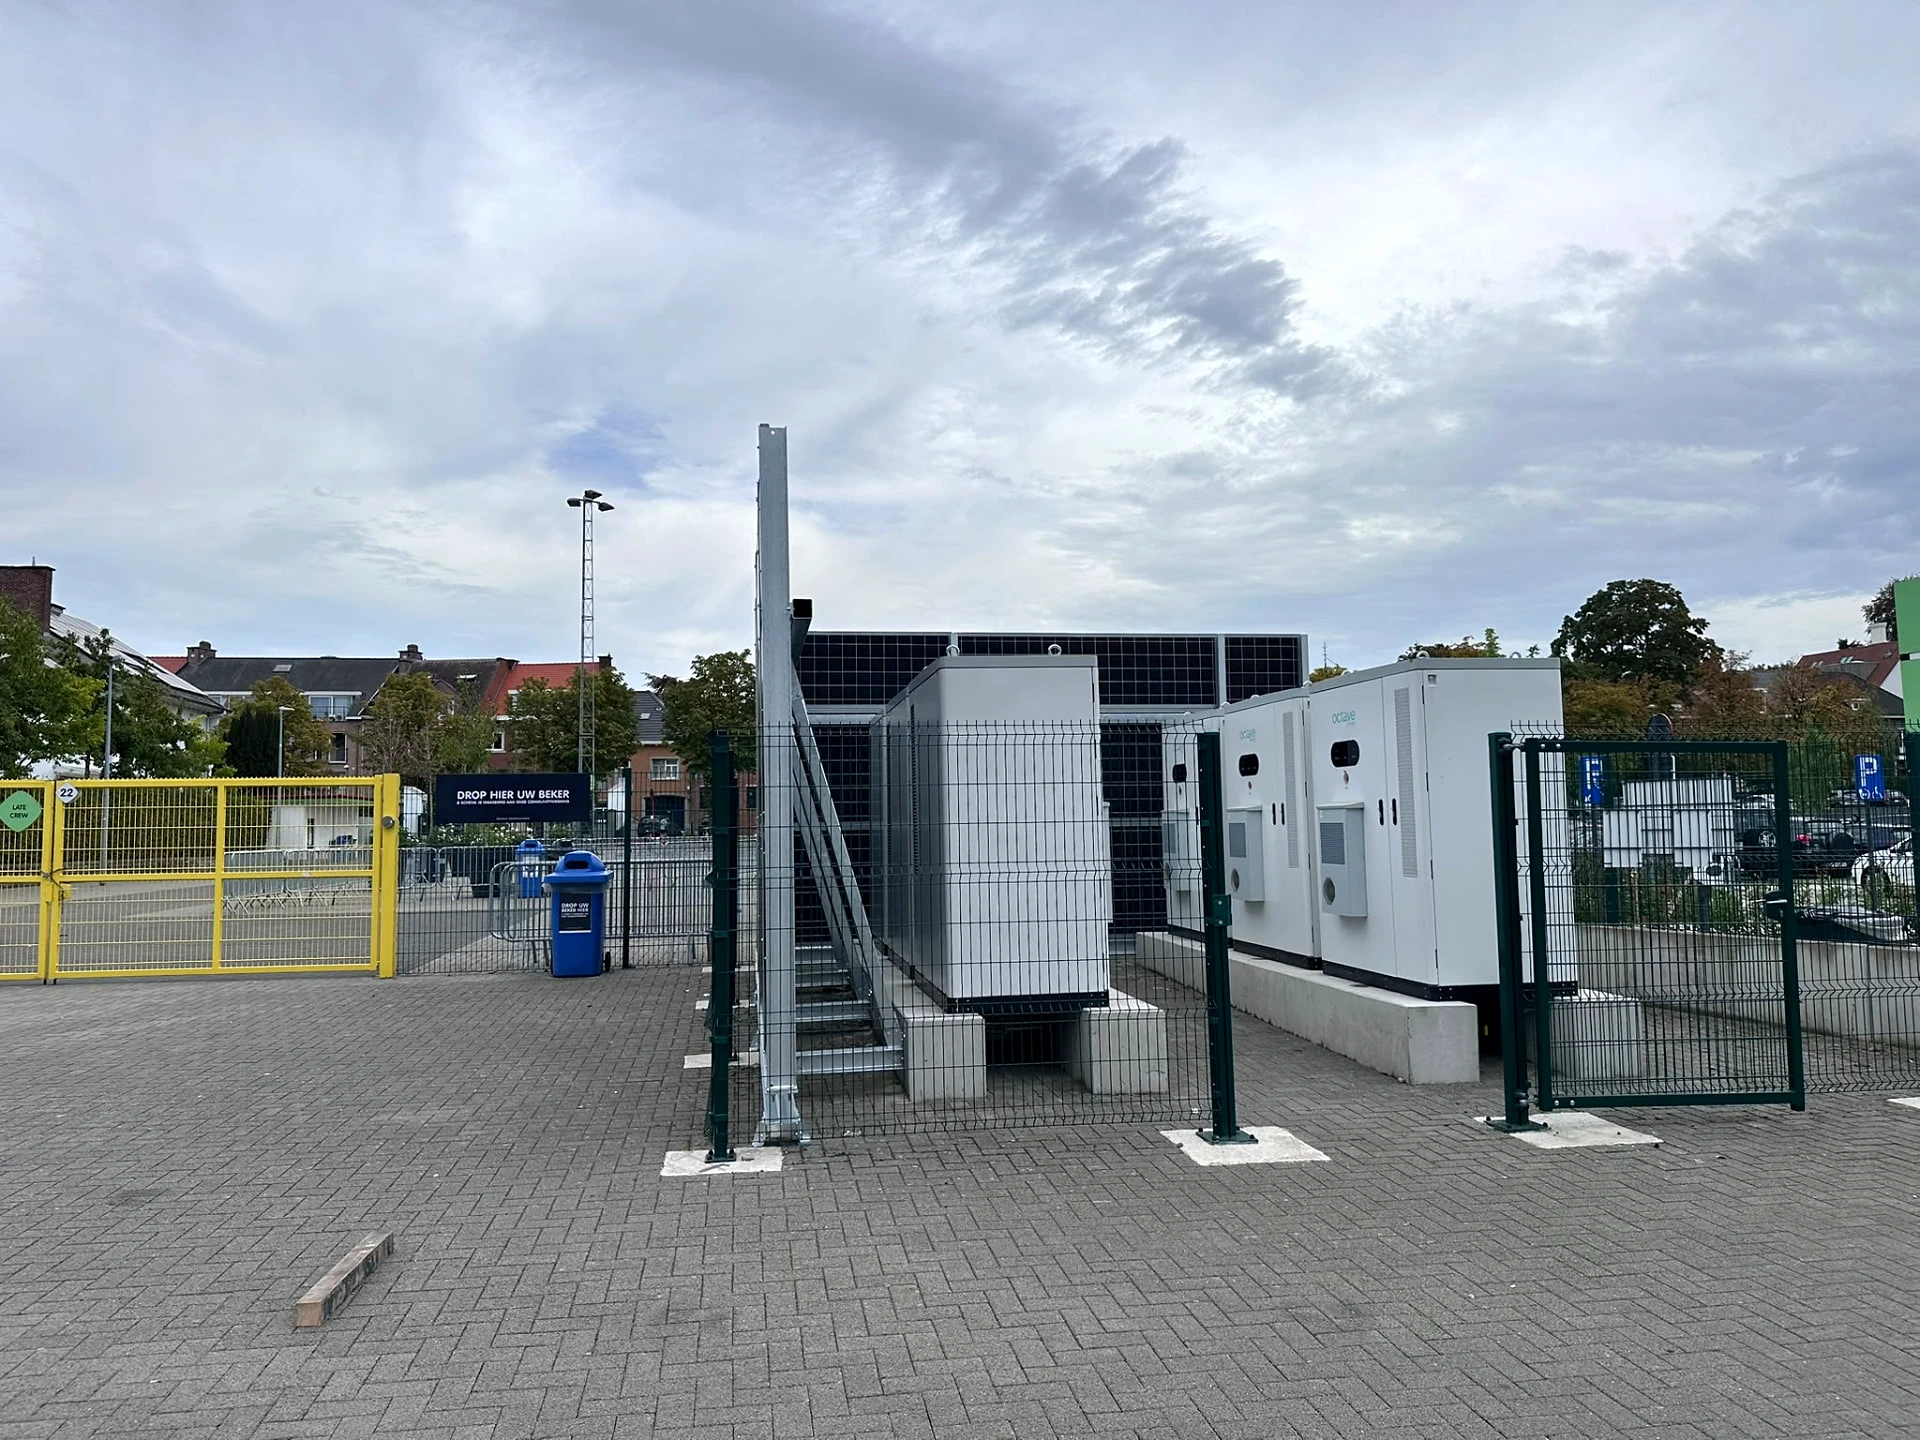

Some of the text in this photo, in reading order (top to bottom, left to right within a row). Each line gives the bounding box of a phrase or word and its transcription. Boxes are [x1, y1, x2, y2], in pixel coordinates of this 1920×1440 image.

[1331, 710, 1356, 724] octave
[1860, 757, 1877, 787] P
[60, 788, 73, 797] 22
[457, 790, 570, 800] DROP HIER UW BEKER
